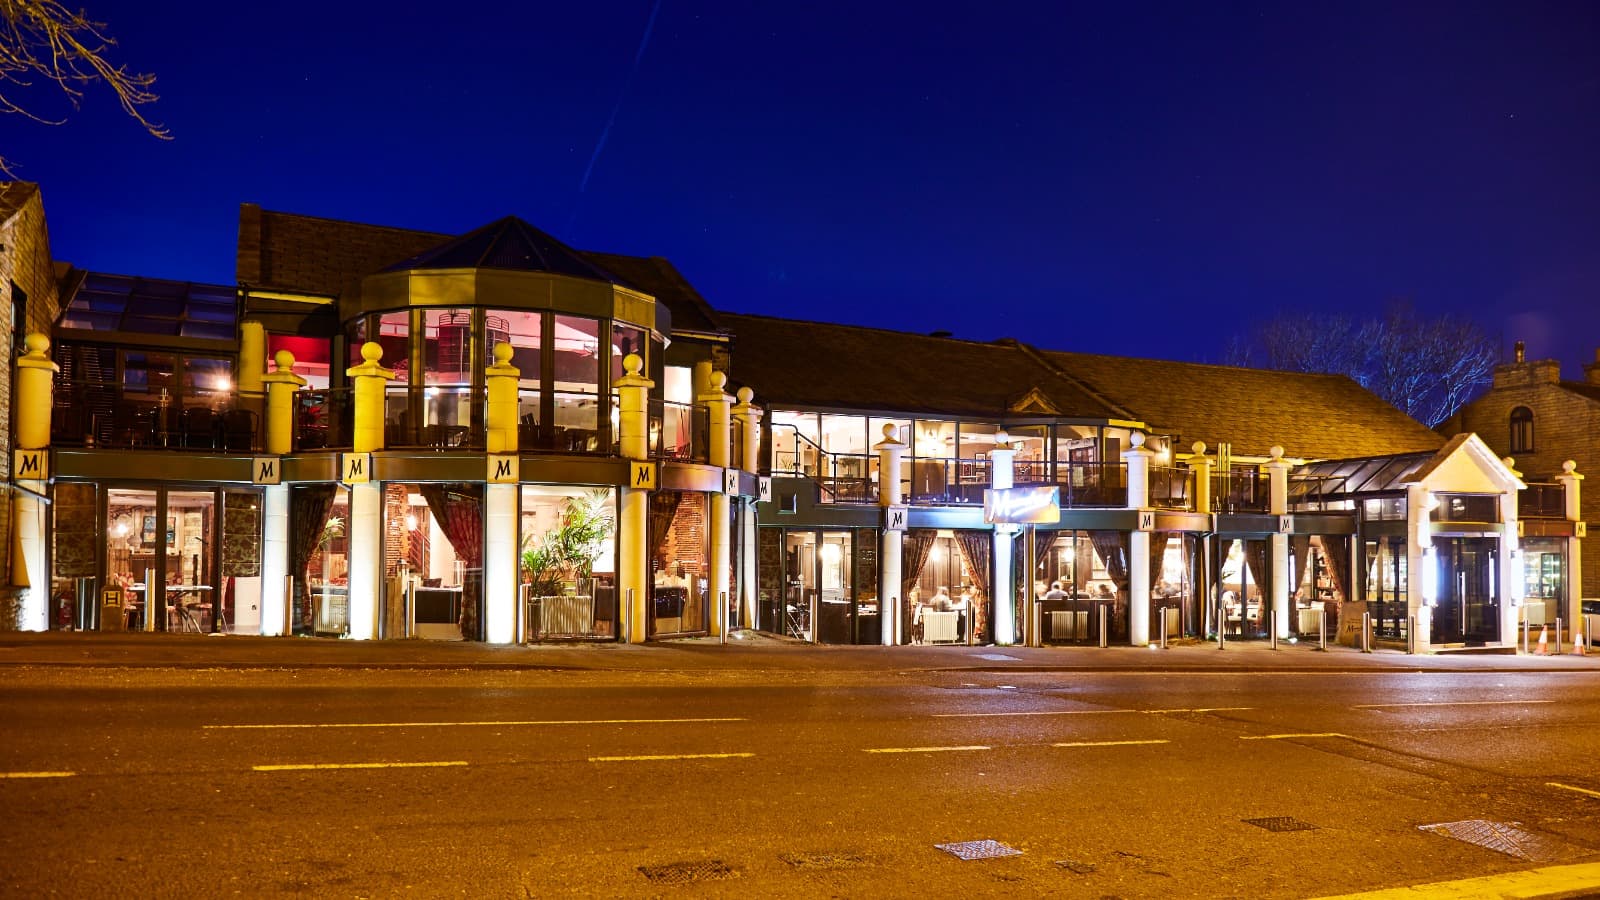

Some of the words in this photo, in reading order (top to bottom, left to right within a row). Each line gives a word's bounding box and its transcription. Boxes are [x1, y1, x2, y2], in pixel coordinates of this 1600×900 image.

[19, 454, 38, 475] M
[259, 461, 274, 481] M
[349, 458, 362, 478] M
[494, 459, 511, 480] M
[636, 466, 650, 485] M
[760, 481, 768, 495] M
[892, 512, 903, 527] M
[1143, 515, 1151, 528] M
[1282, 519, 1290, 531] M
[106, 592, 118, 605] H
